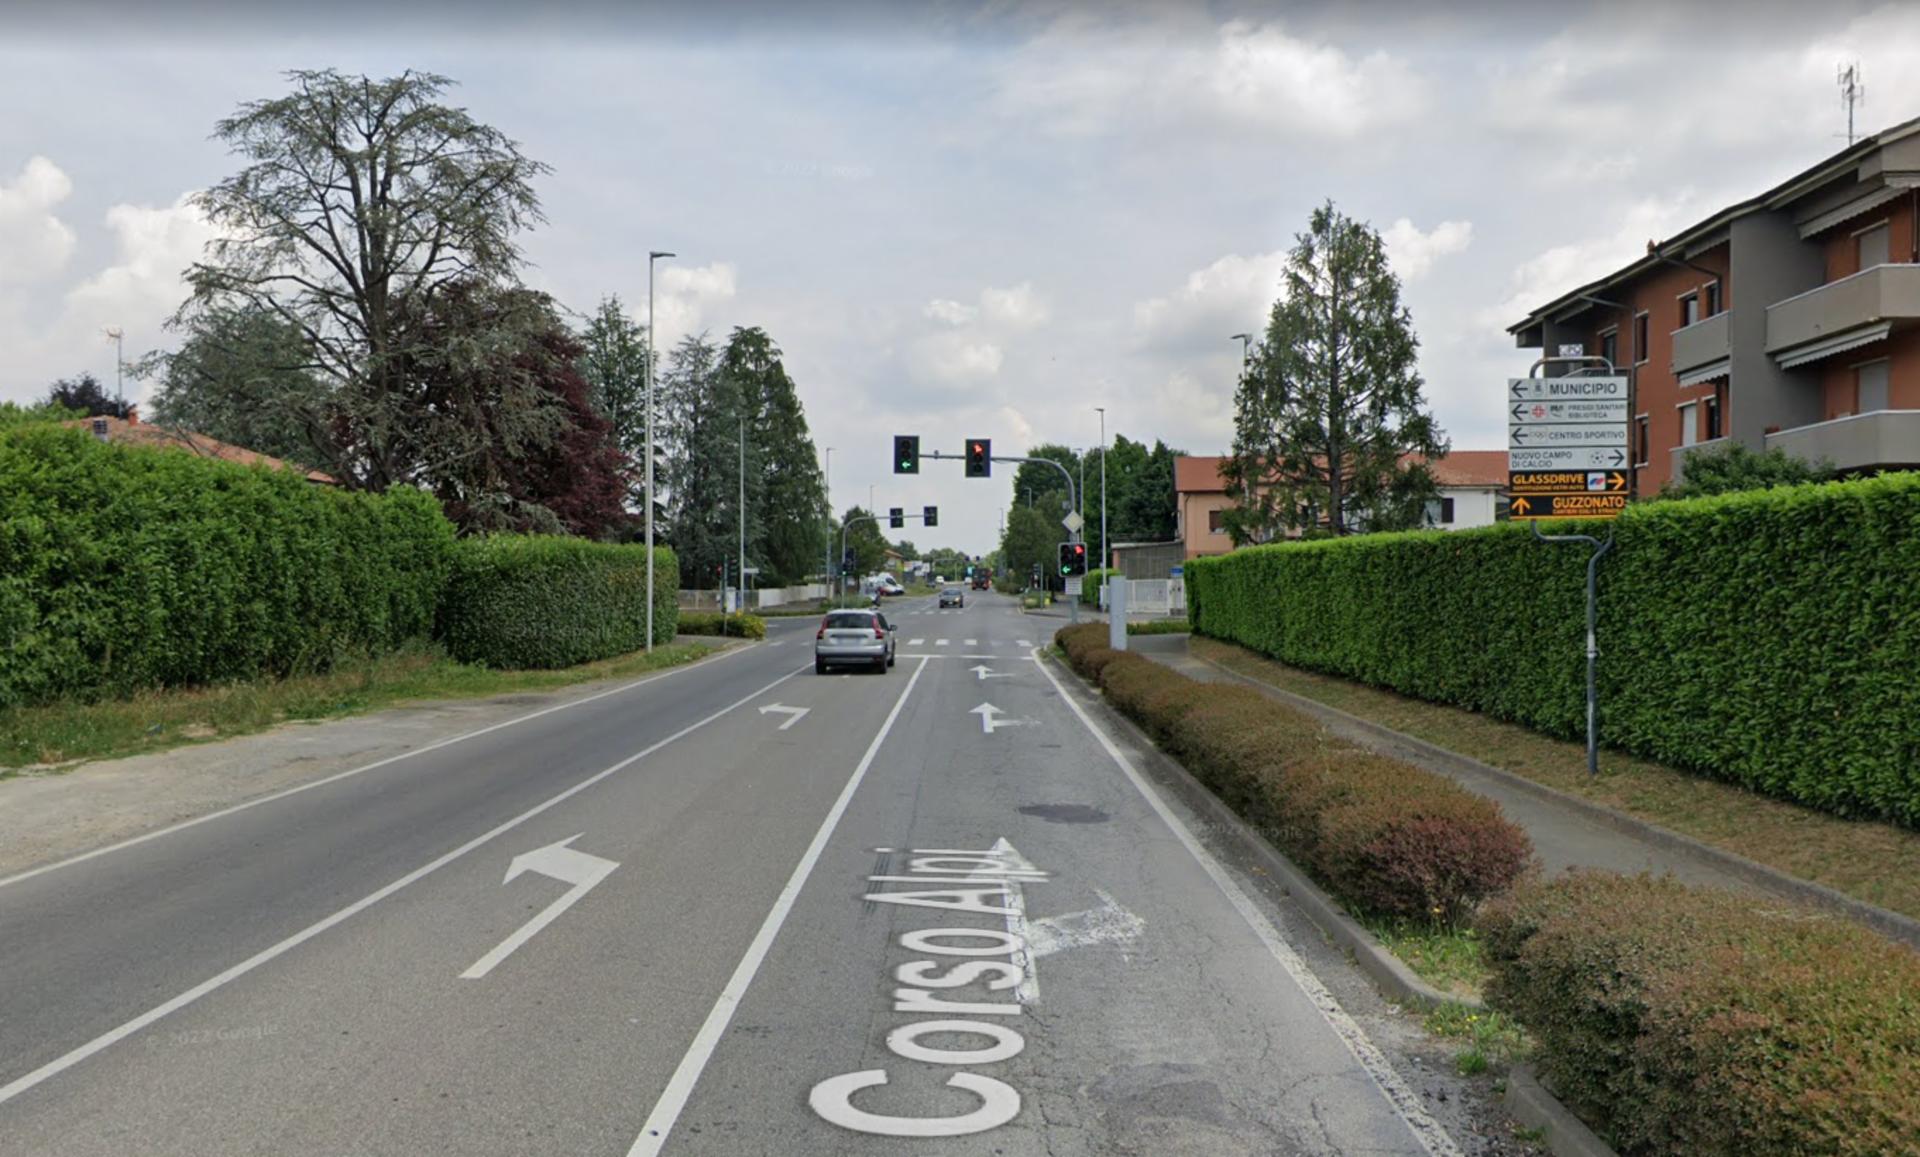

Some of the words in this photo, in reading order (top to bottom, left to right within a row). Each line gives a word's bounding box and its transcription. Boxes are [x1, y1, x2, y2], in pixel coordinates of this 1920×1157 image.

[1549, 383, 1617, 395] MUNICIPIO
[1548, 431, 1582, 440] CENTRO
[1583, 430, 1625, 439] SPORTIVO
[1512, 451, 1541, 460] NUOVO
[1543, 450, 1573, 459] CAMPO
[1512, 459, 1520, 468] DI
[1521, 459, 1553, 468] CALCIO
[1512, 473, 1585, 484] GLASSDRIVE
[1552, 495, 1625, 509] GUZZONATO
[861, 847, 1050, 916] Alpi
[807, 927, 1026, 1137] Corso
